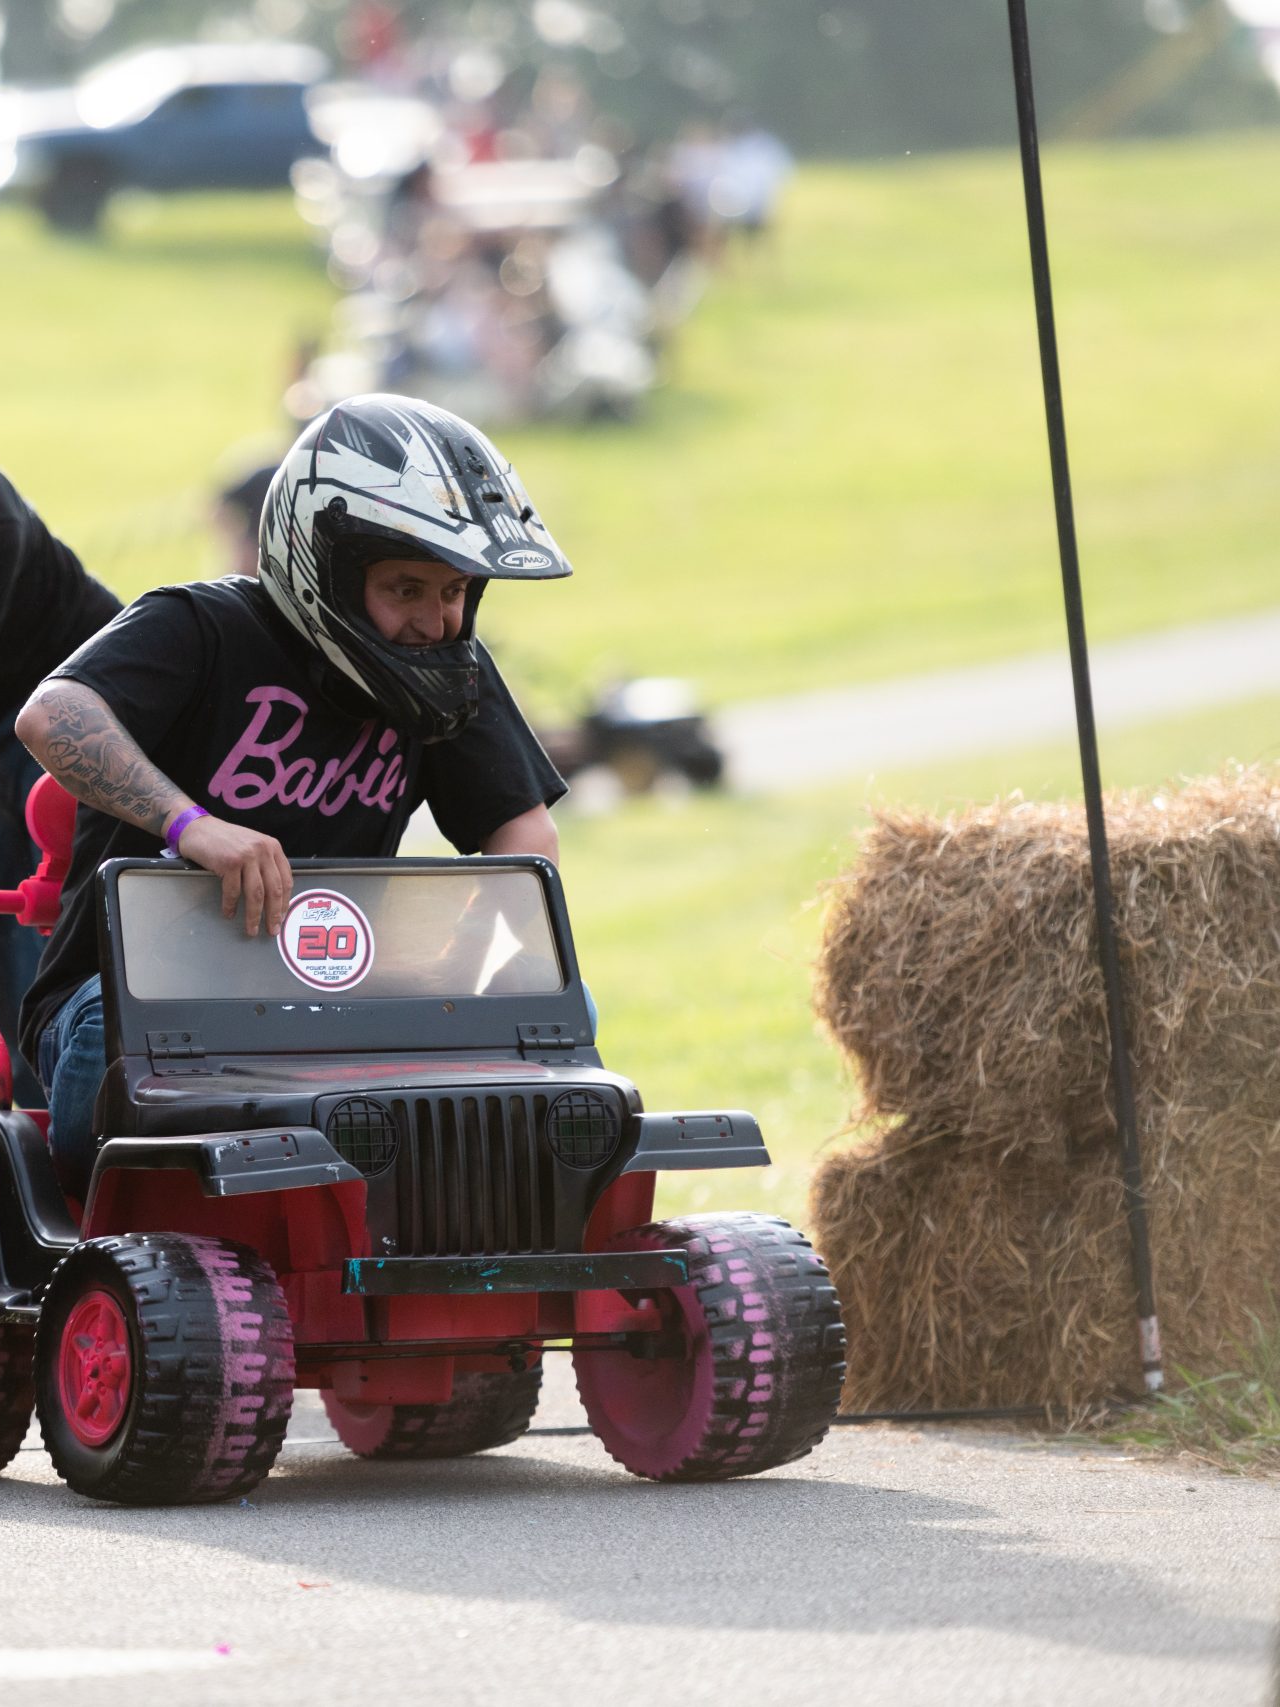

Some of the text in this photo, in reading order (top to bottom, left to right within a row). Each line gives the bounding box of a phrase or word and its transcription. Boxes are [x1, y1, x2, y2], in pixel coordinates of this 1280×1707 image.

[500, 551, 549, 568] GMAX
[207, 685, 407, 817] Barbie
[297, 925, 357, 960] 20
